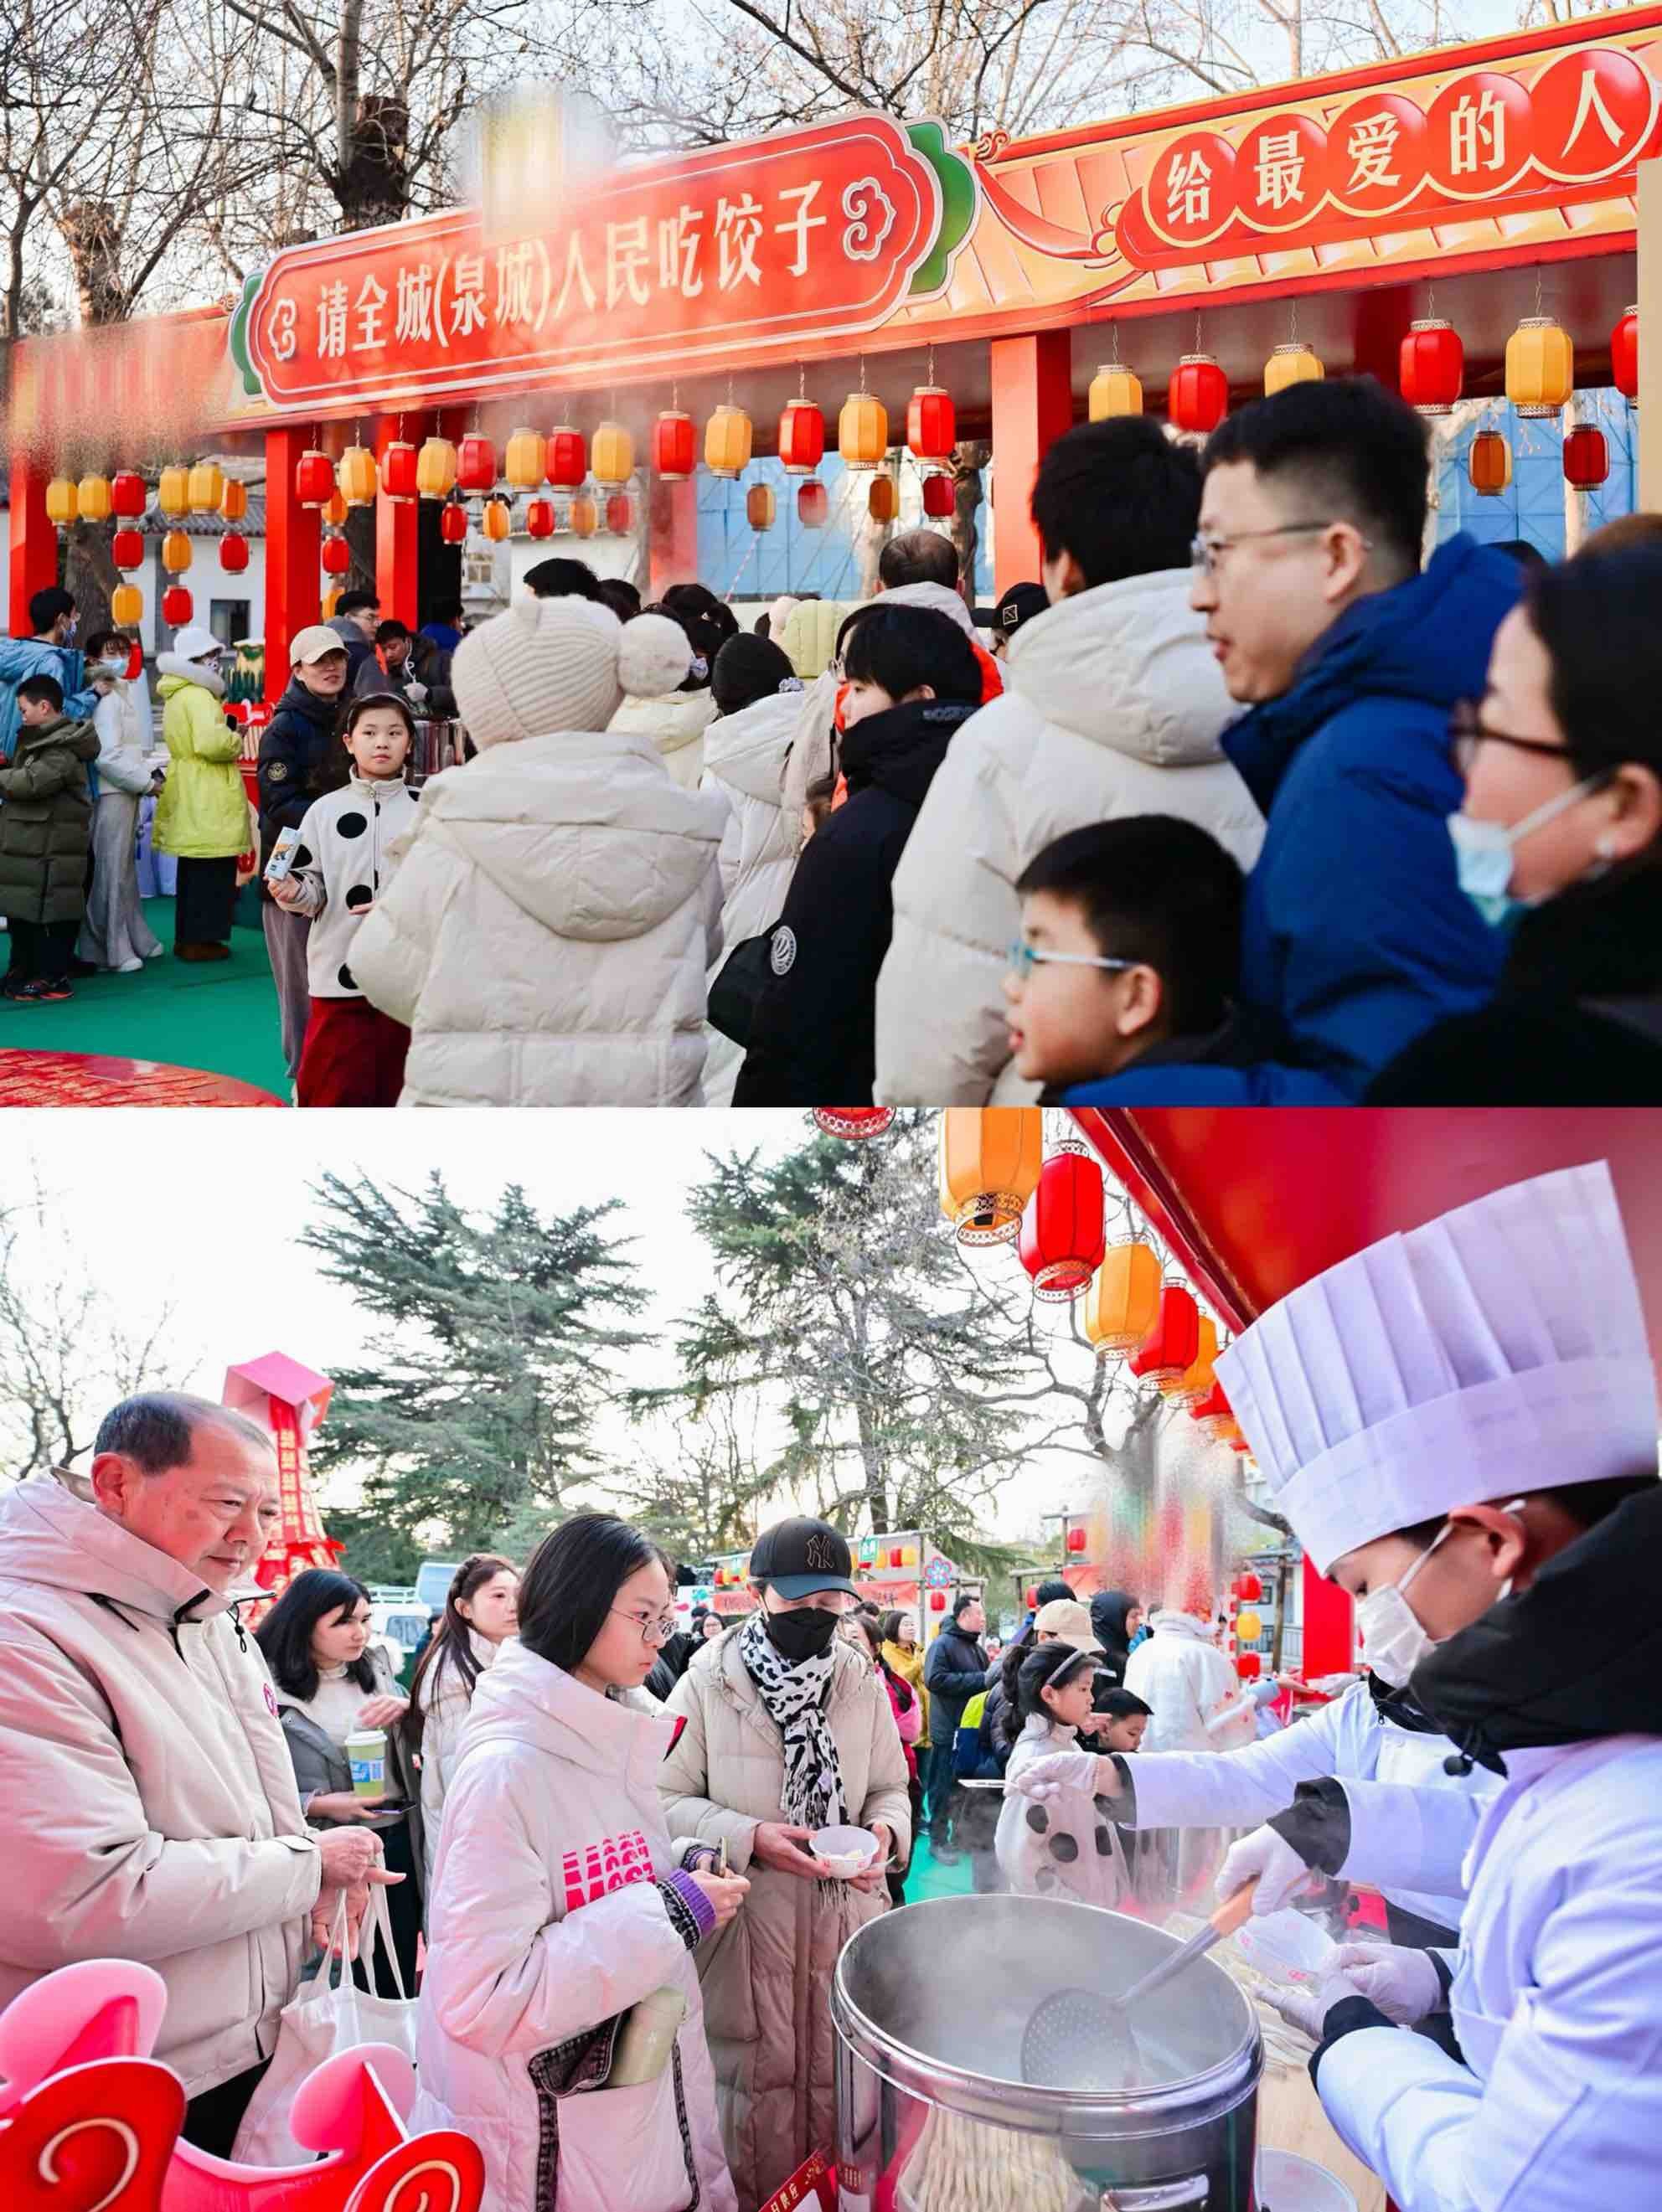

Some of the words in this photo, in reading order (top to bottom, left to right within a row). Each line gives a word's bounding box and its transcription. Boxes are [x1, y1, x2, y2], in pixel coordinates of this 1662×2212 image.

[1166, 70, 1625, 225] 给最爱的人
[807, 1534, 835, 1569] NY
